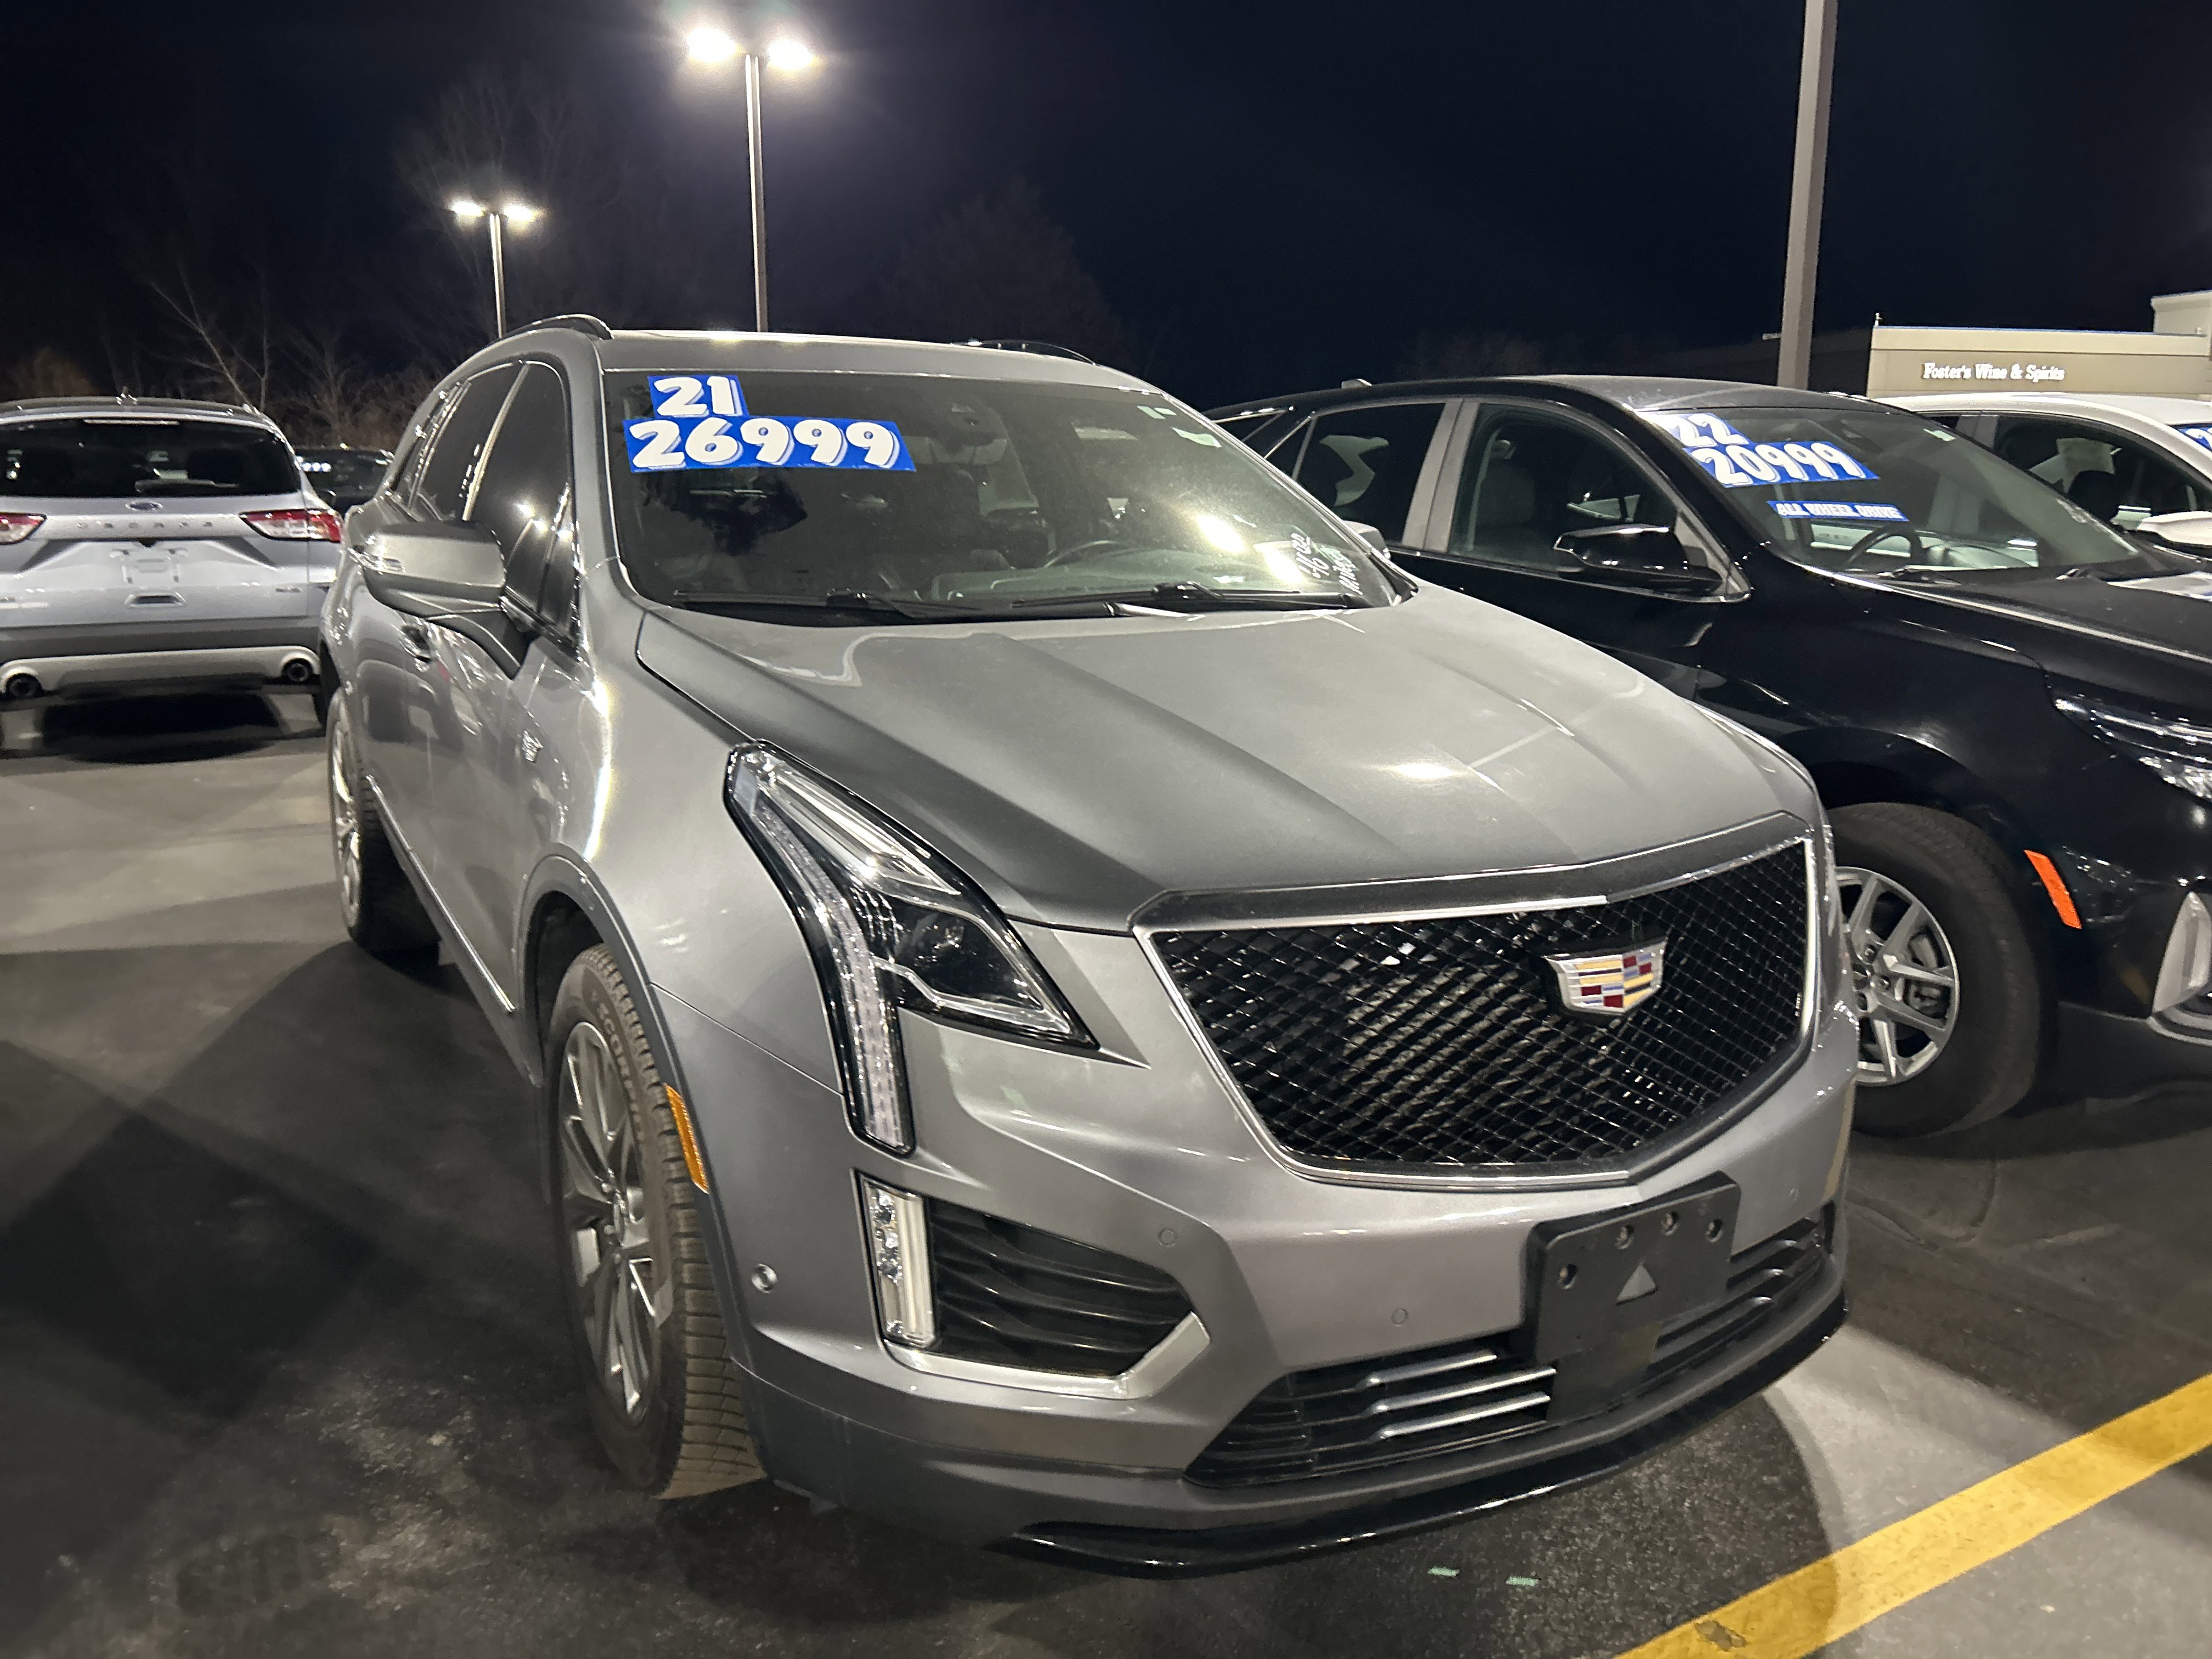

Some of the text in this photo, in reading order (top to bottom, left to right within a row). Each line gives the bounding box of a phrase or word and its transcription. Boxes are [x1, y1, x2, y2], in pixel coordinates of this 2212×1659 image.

[1923, 363, 2065, 383] Foster's Wine & Spirits
[653, 375, 743, 417] 21
[629, 417, 901, 469] 26999
[1656, 413, 1750, 448] 22
[1691, 442, 1867, 486] 20999
[1776, 503, 1905, 519] ALL WHEEL DRIVE
